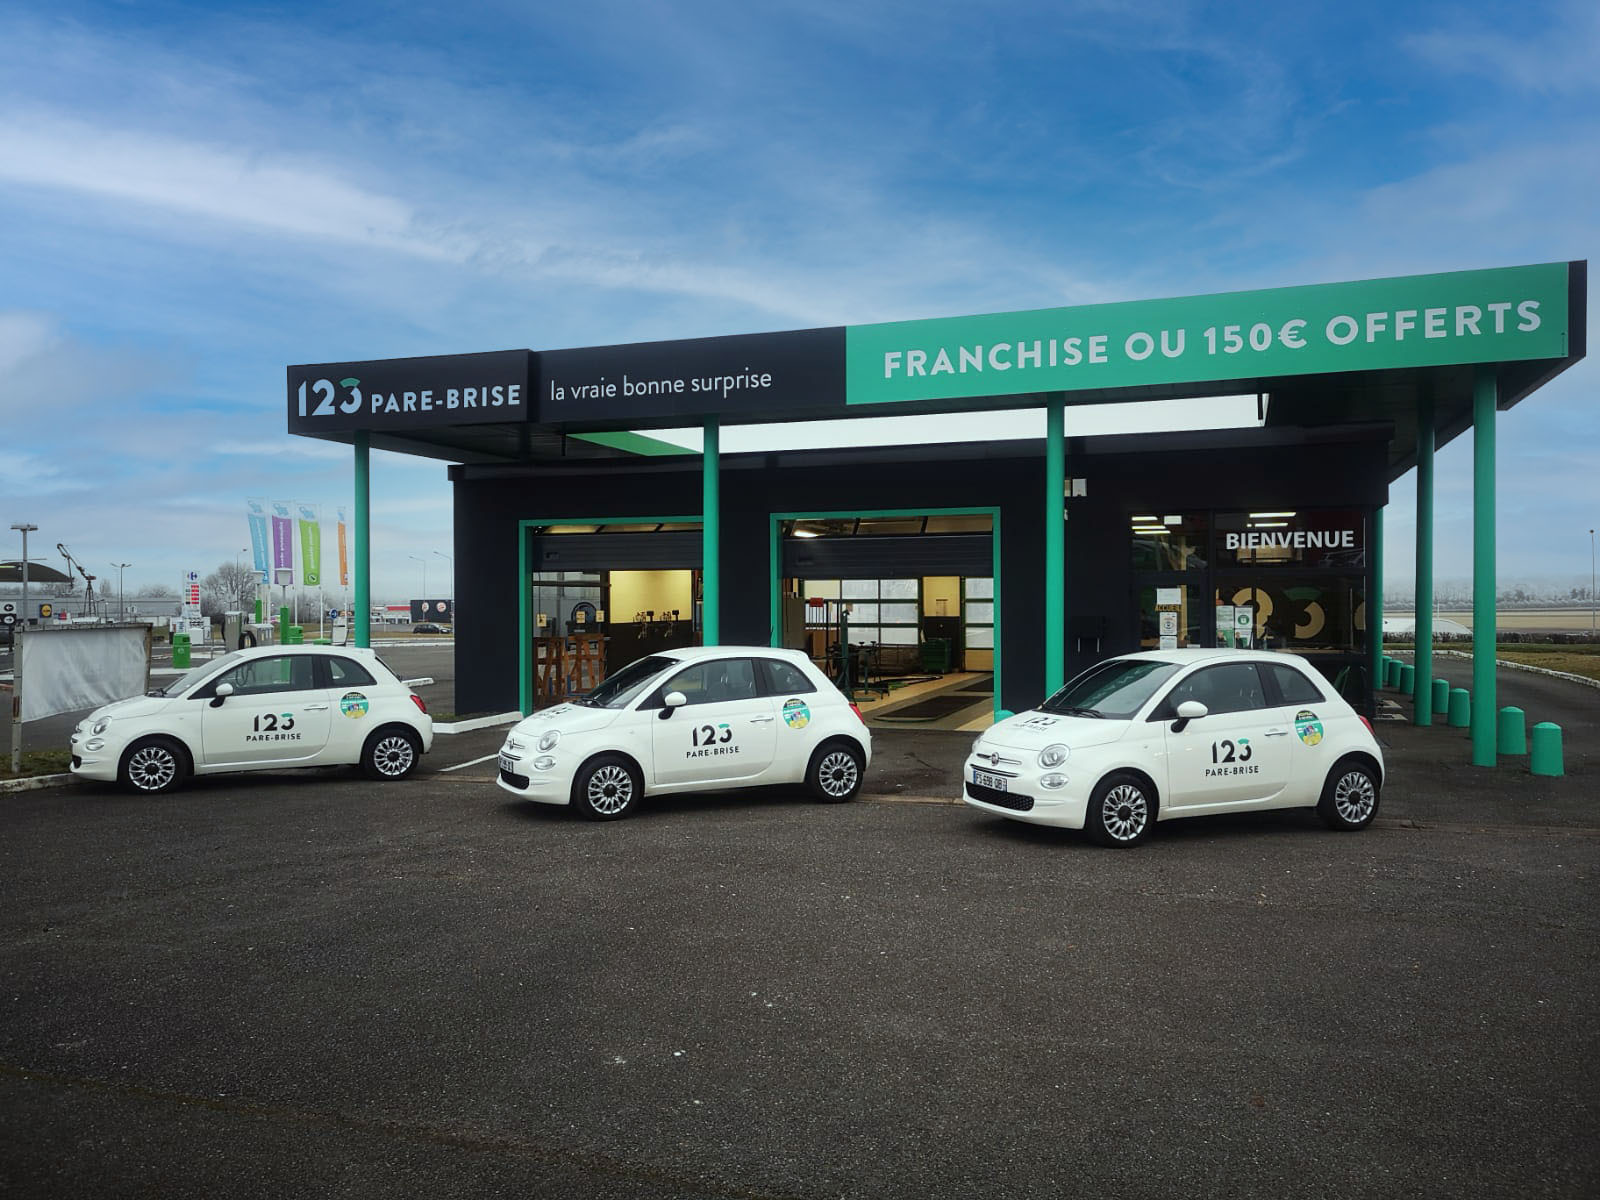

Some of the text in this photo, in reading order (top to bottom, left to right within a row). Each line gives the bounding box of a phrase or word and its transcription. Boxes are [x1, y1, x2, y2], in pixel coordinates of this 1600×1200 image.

[884, 300, 1542, 379] FRANCHISE OU 150€ OFFERTS
[551, 366, 773, 401] la vraie bonne surprise
[298, 377, 521, 417] 123 PARE-BRISE
[1225, 530, 1355, 550] BIENVENUE
[253, 712, 295, 732] 123
[246, 733, 302, 741] PARE-BRISE
[692, 723, 733, 747] 123
[686, 745, 741, 759] PARE-BRISE
[1211, 737, 1253, 764] 123
[1205, 765, 1260, 777] PARE-BRISE
